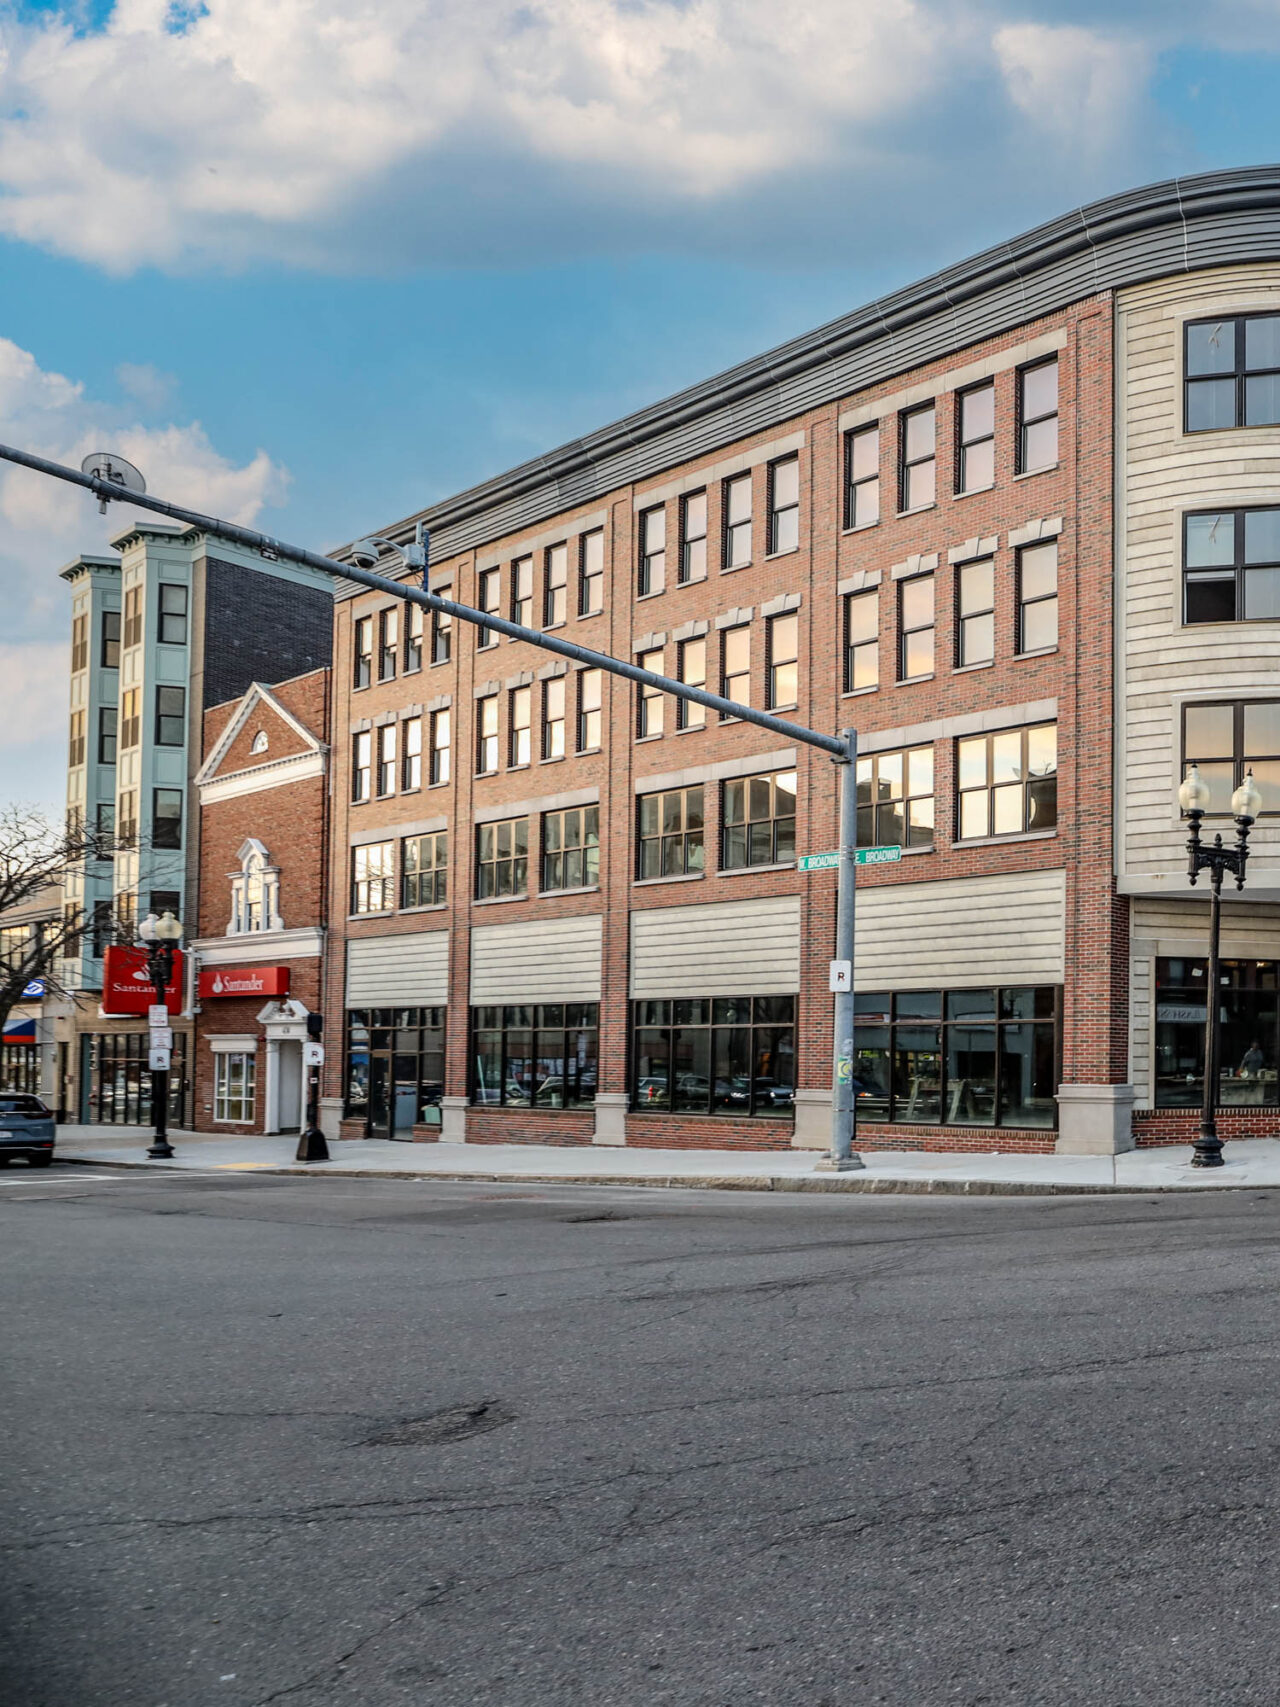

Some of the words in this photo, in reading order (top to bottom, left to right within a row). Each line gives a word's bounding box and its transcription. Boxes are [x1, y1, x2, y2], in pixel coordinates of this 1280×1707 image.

[866, 850, 900, 862] BROADWAY
[113, 982, 176, 994] Santaner
[223, 973, 264, 992] Santander
